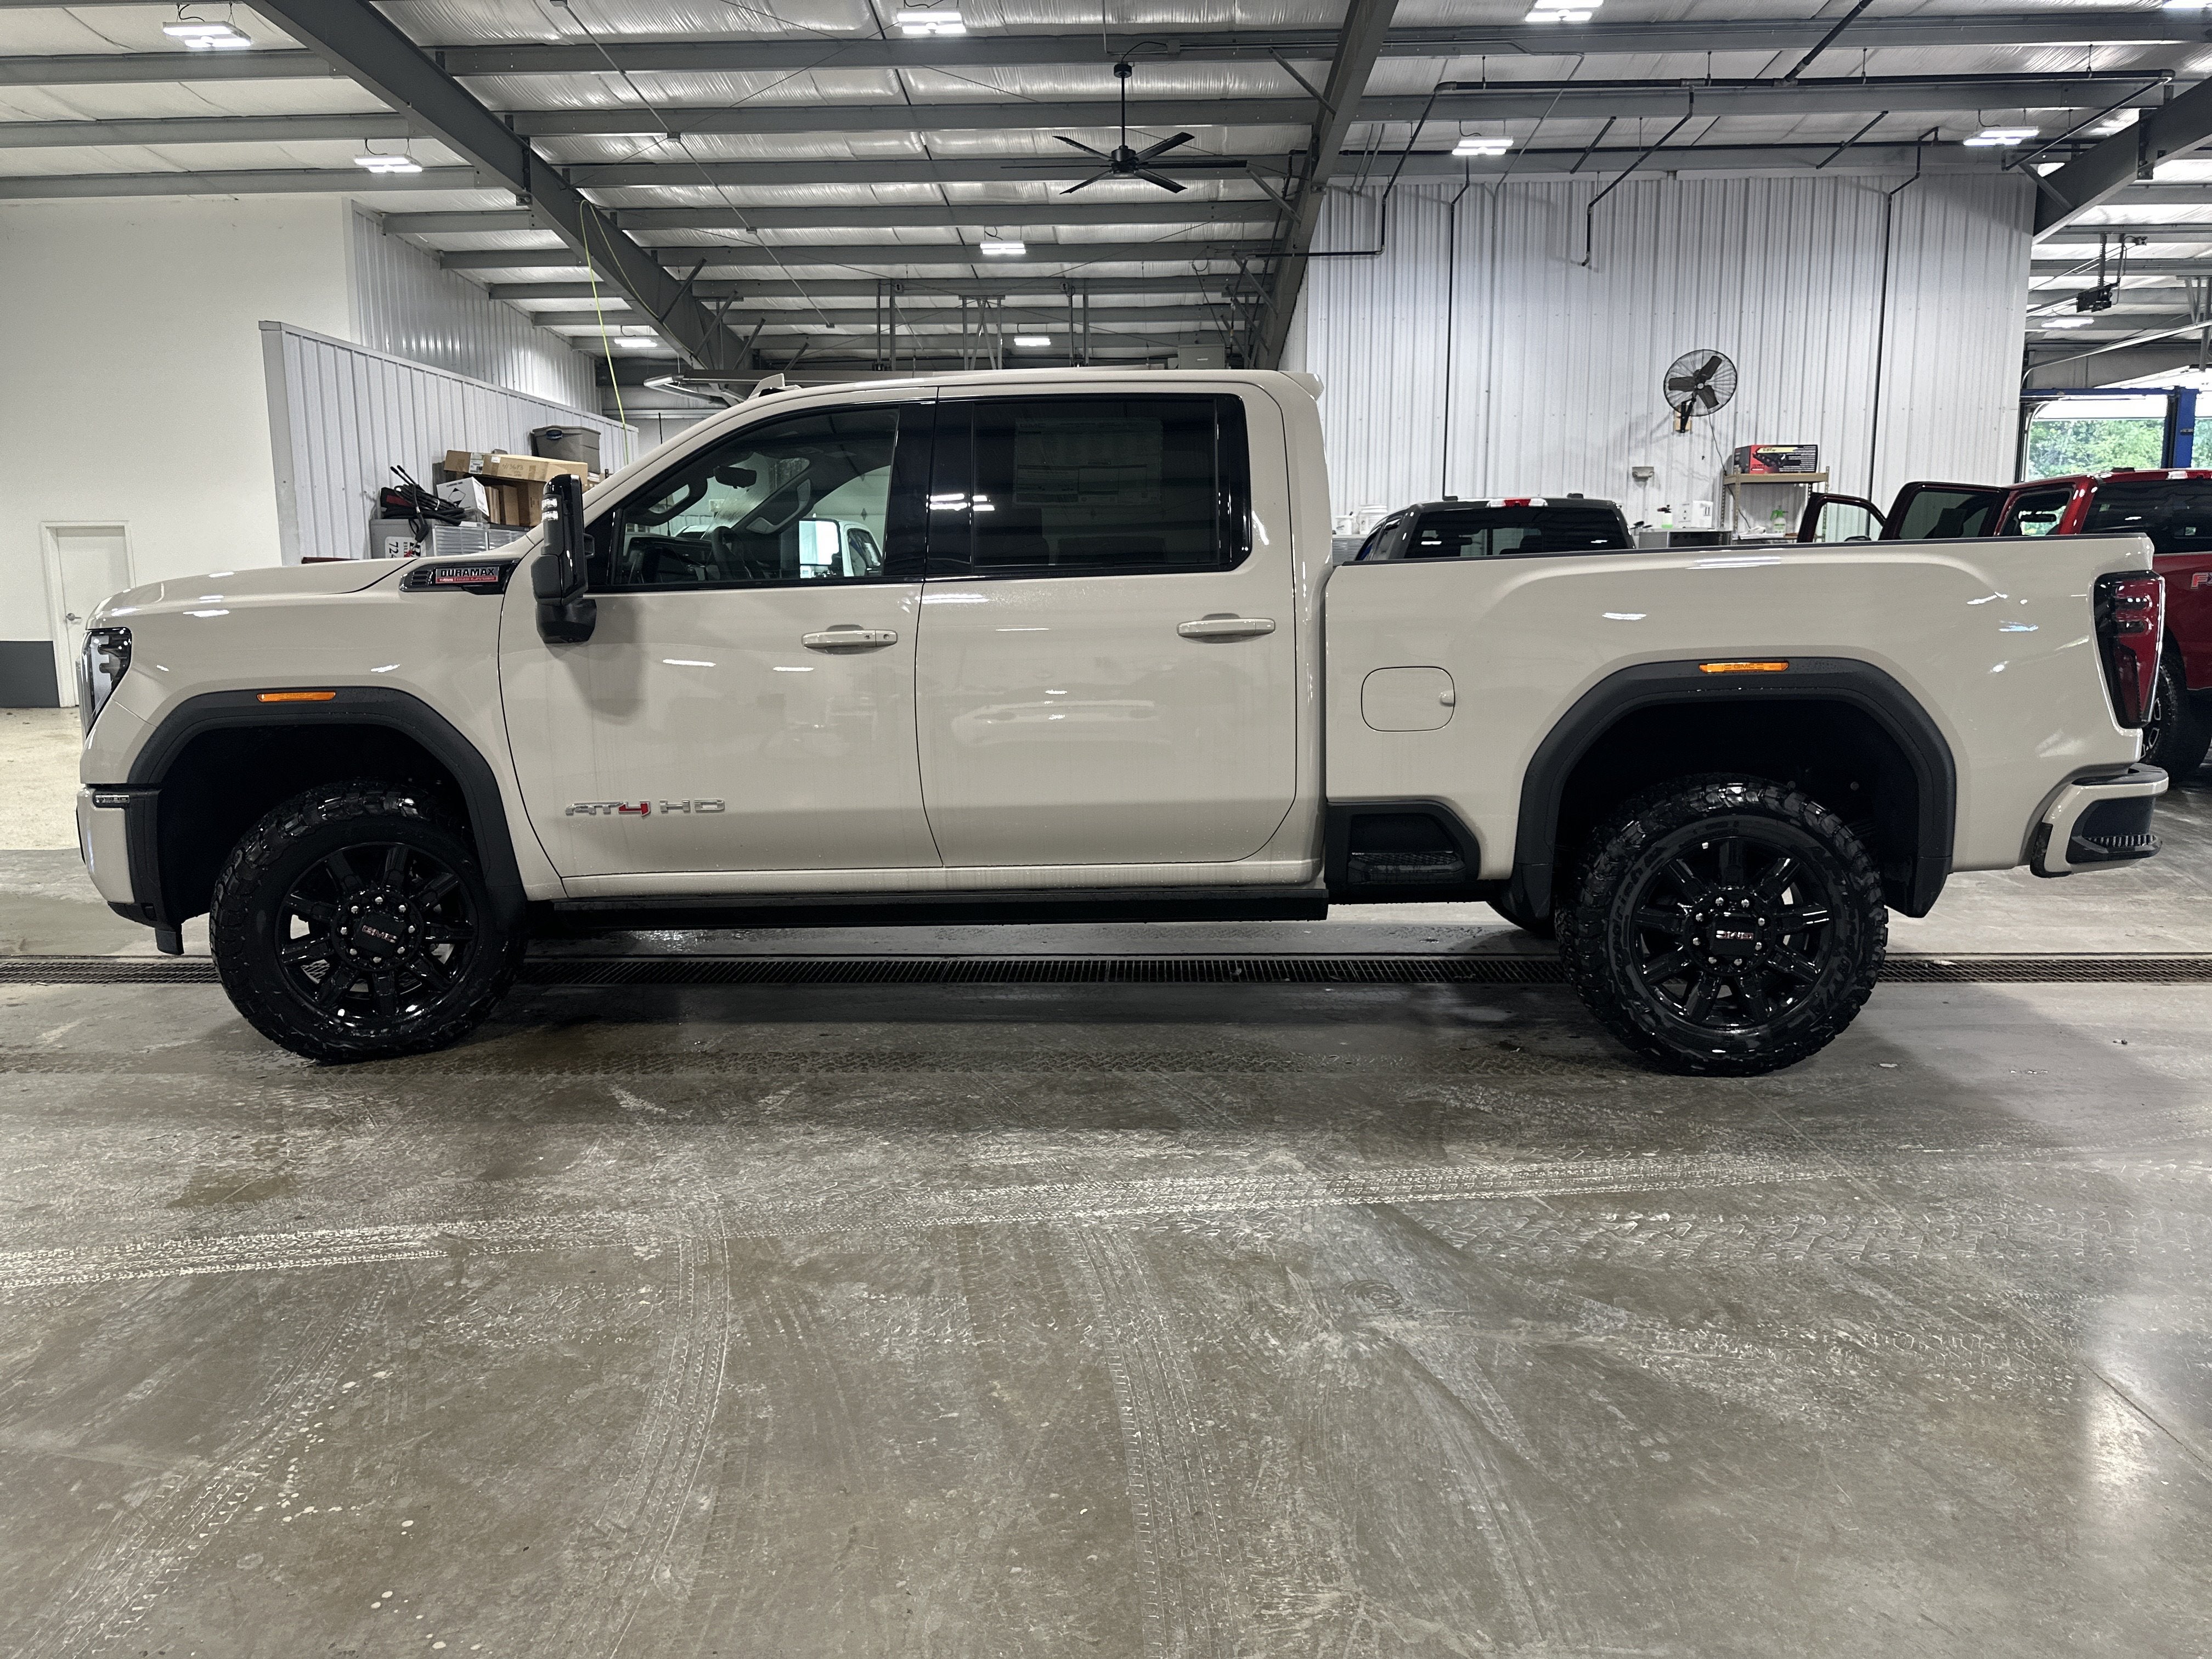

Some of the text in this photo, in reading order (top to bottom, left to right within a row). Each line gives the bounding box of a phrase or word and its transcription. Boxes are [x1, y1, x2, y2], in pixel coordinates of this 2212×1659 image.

[441, 568, 494, 577] DURAMAX
[566, 799, 725, 816] AT4 HD
[362, 925, 398, 943] GMC
[1716, 930, 1754, 940] GMC
